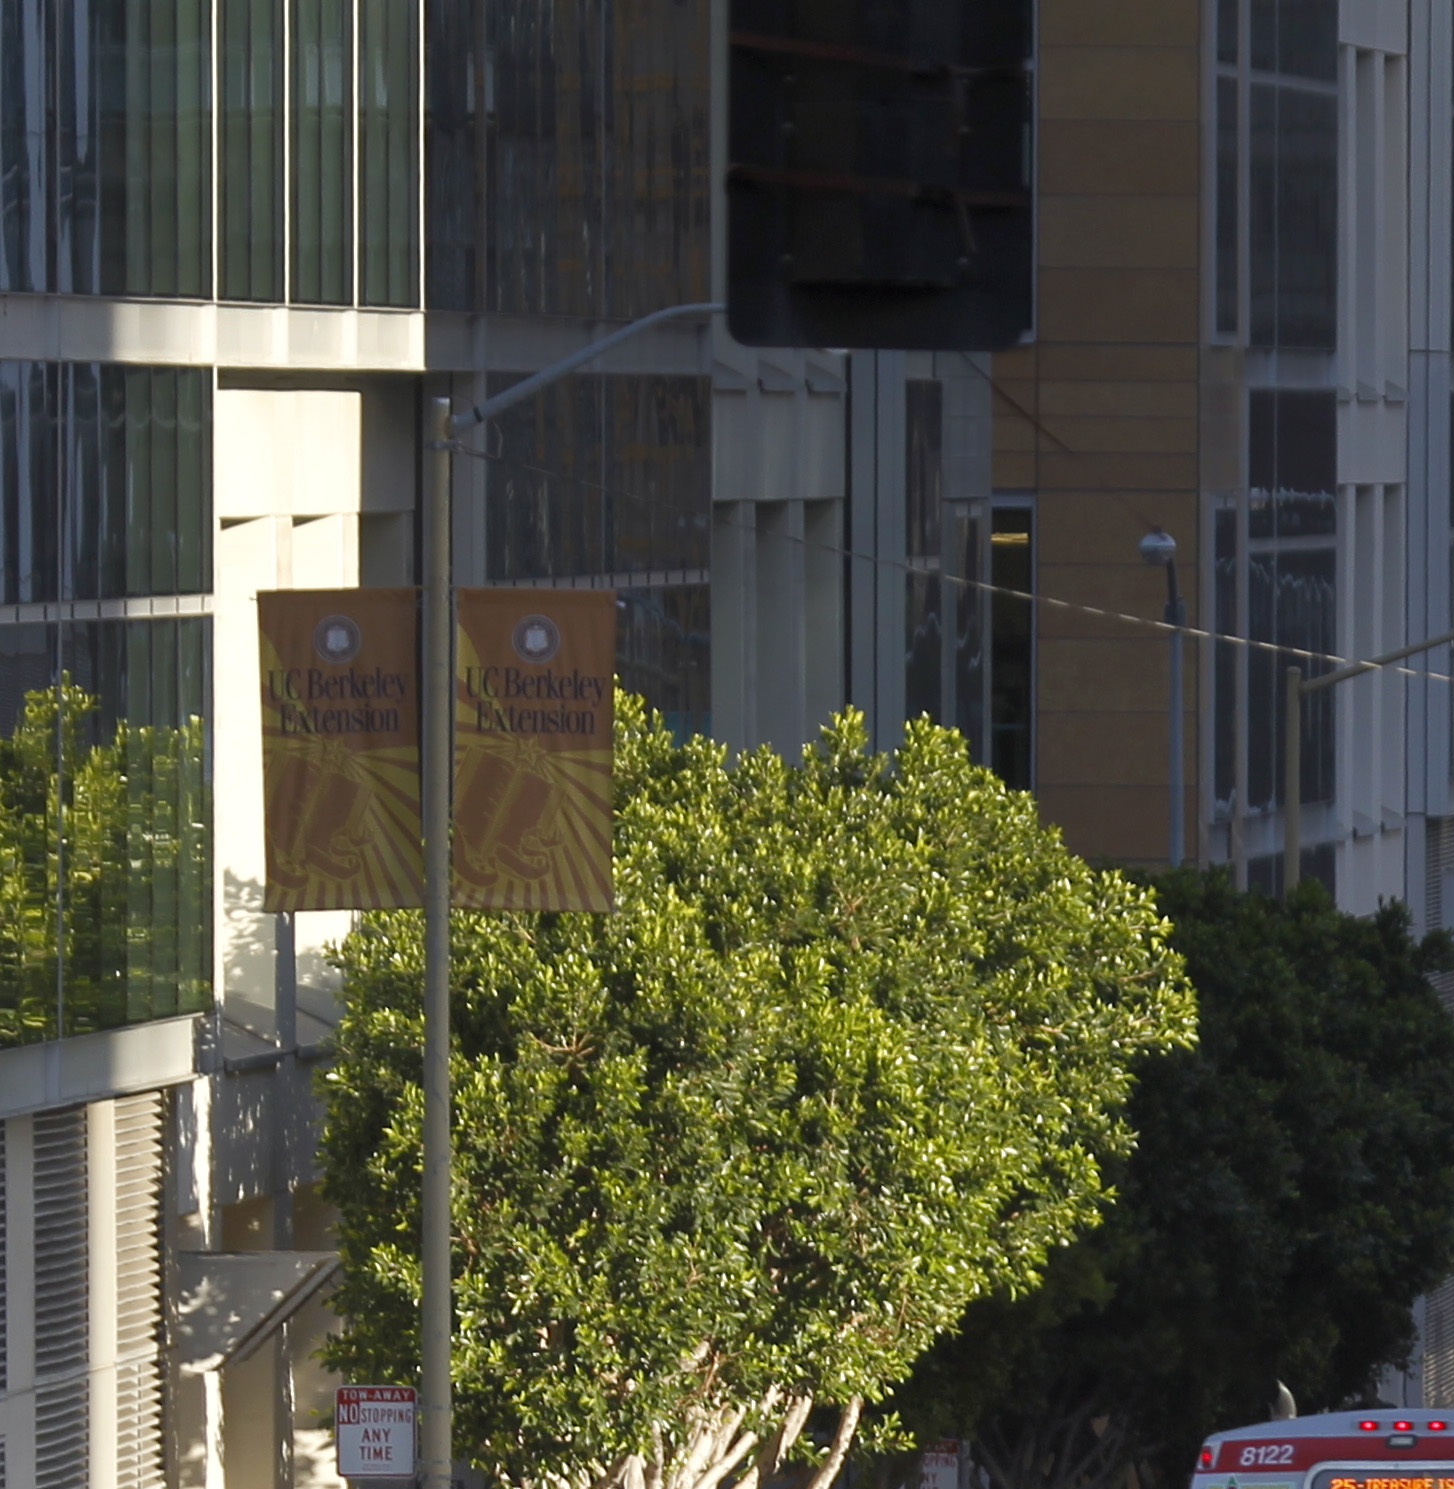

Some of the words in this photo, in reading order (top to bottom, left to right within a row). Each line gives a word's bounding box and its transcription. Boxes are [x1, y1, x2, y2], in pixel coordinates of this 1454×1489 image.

[269, 668, 299, 700] UC
[307, 667, 408, 702] Berkeley
[465, 667, 498, 699] UC
[505, 668, 607, 706] Berkeley
[280, 701, 400, 735] Extension
[477, 702, 596, 735] Extension
[342, 1389, 411, 1400] TOW-AWAY
[339, 1403, 359, 1423] NO
[361, 1407, 412, 1423] STOPPING
[361, 1428, 392, 1442] ANY
[360, 1446, 393, 1461] TIME
[1239, 1444, 1294, 1466] 8122
